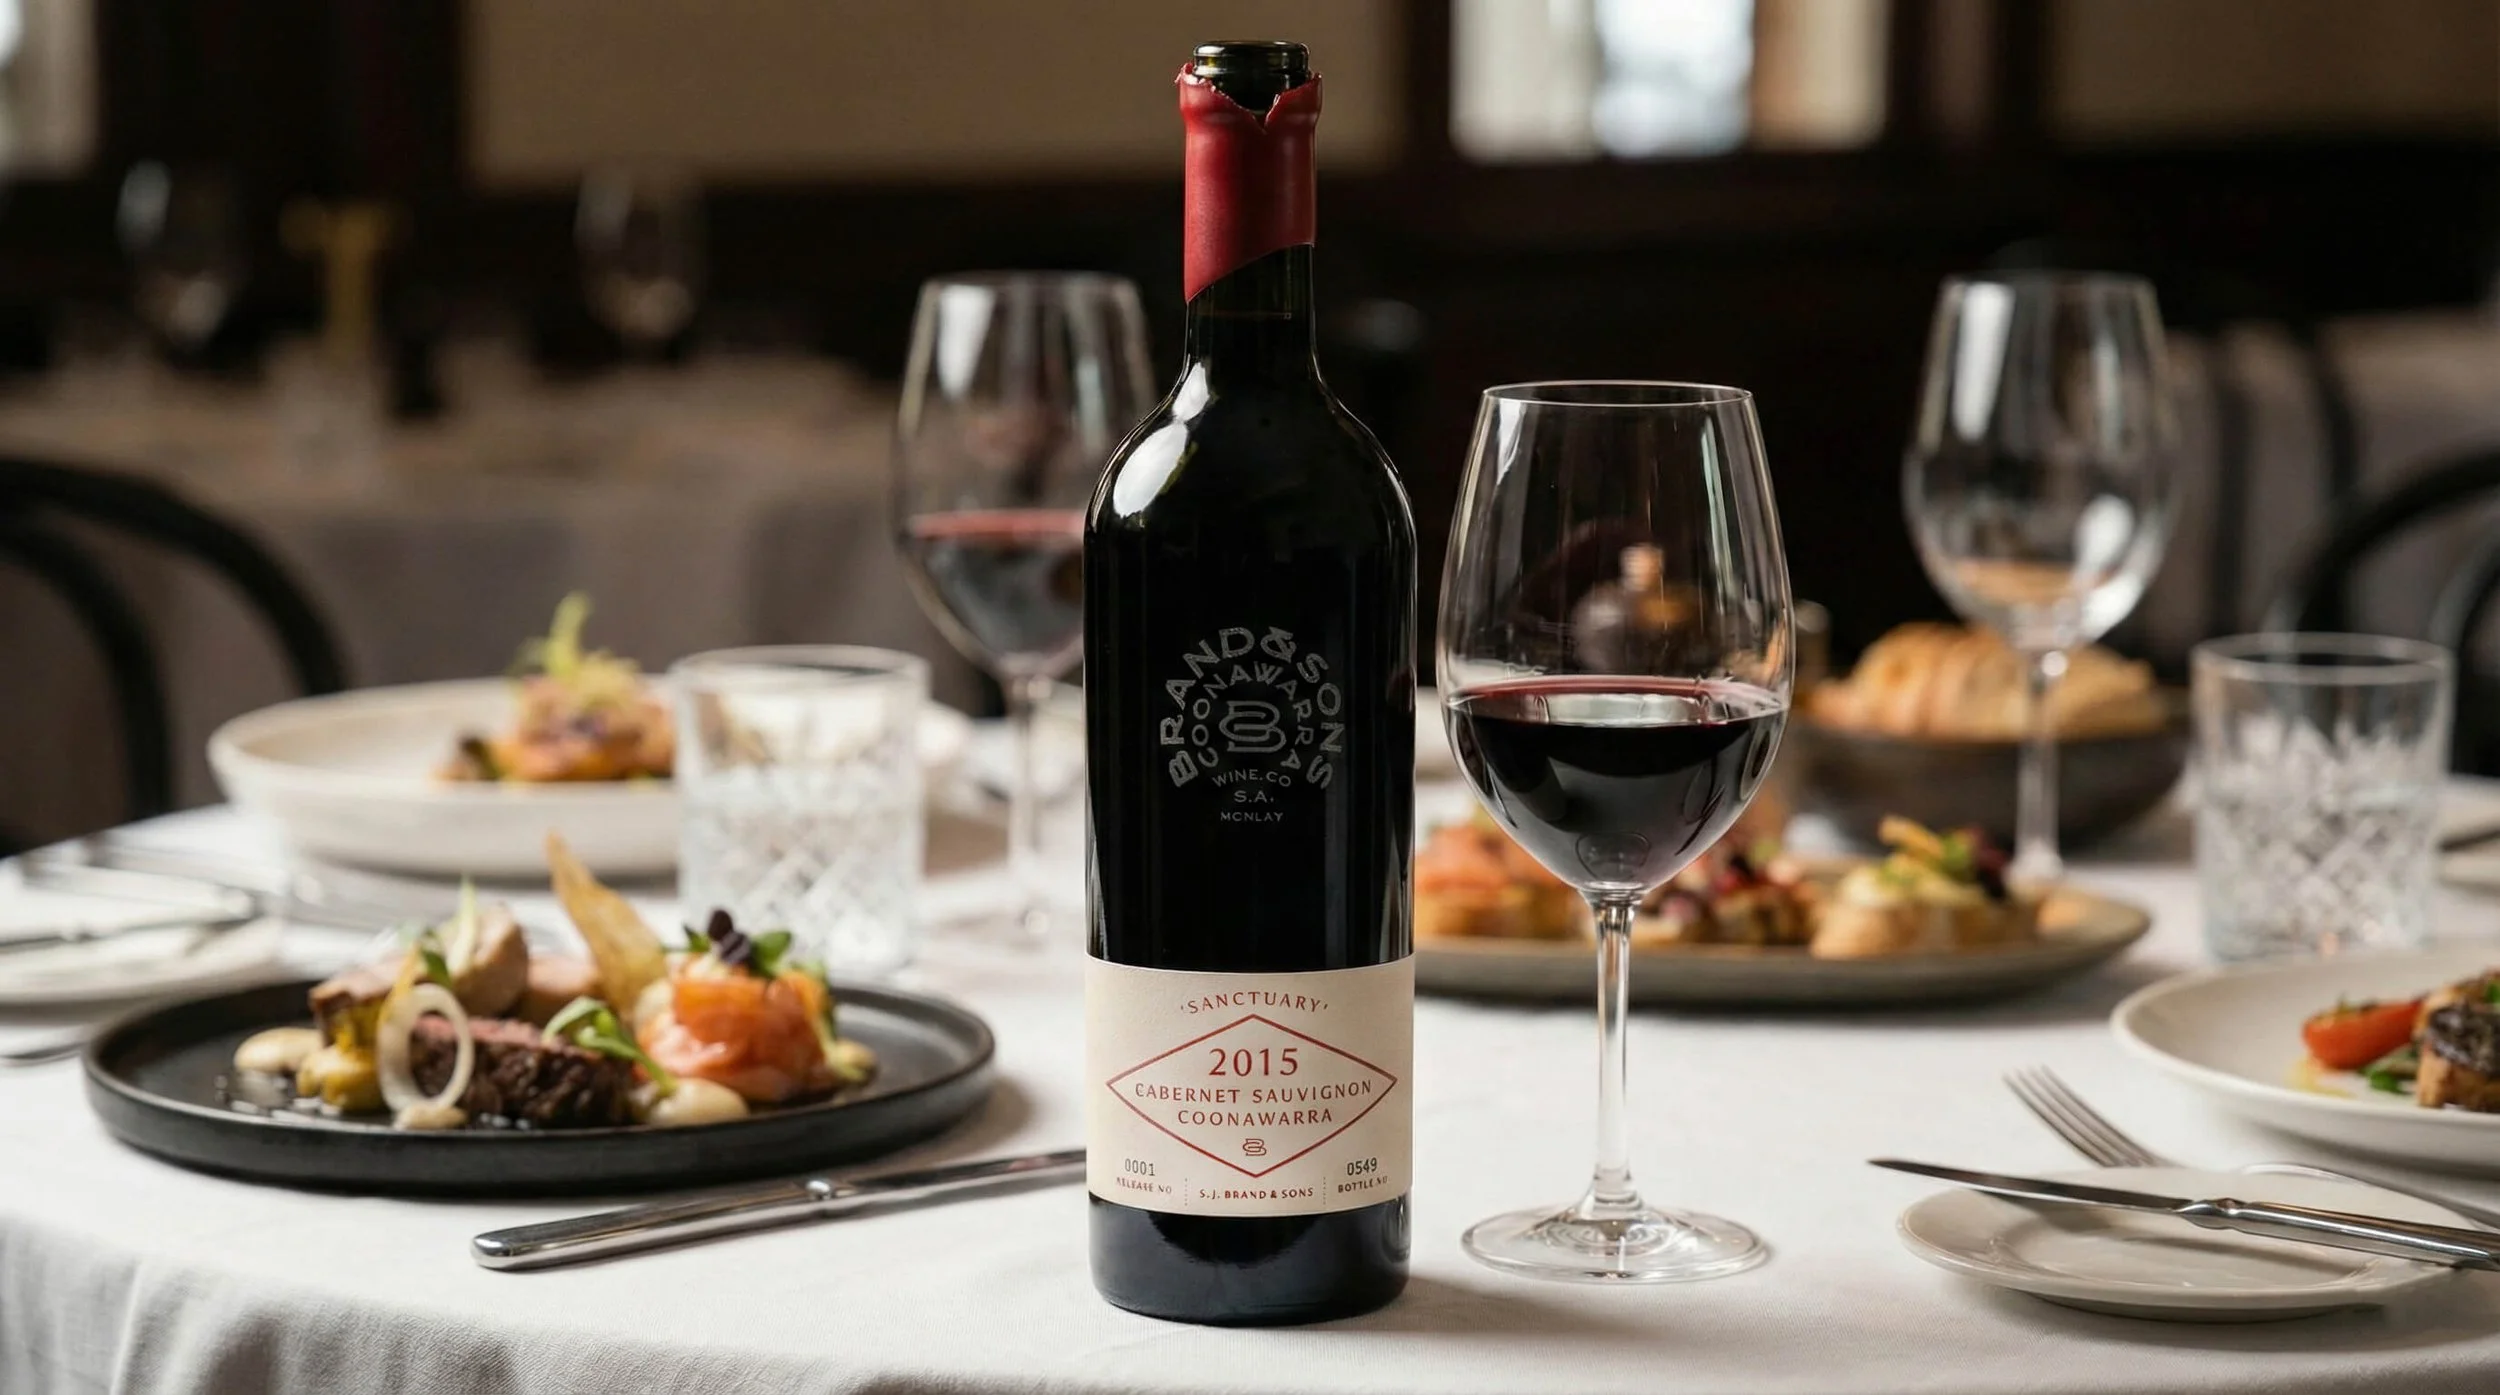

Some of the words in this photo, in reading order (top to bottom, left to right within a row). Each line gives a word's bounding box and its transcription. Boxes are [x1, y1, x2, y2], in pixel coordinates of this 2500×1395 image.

[1160, 627, 1254, 787] BRAND
[1296, 653, 1345, 789] SONS
[1191, 661, 1314, 770] COONAWARRA
[1208, 1047, 1299, 1076] 2015
[1135, 1083, 1240, 1104] CABERNET
[1253, 1079, 1372, 1103] SAUVIGNON
[1178, 1108, 1333, 1127] COONAWARRA
[1125, 1158, 1155, 1176] 0001
[1347, 1157, 1378, 1176] 0549
[1224, 1190, 1266, 1200] BRAND
[1270, 1190, 1277, 1199] &
[1281, 1187, 1314, 1199] SONS
